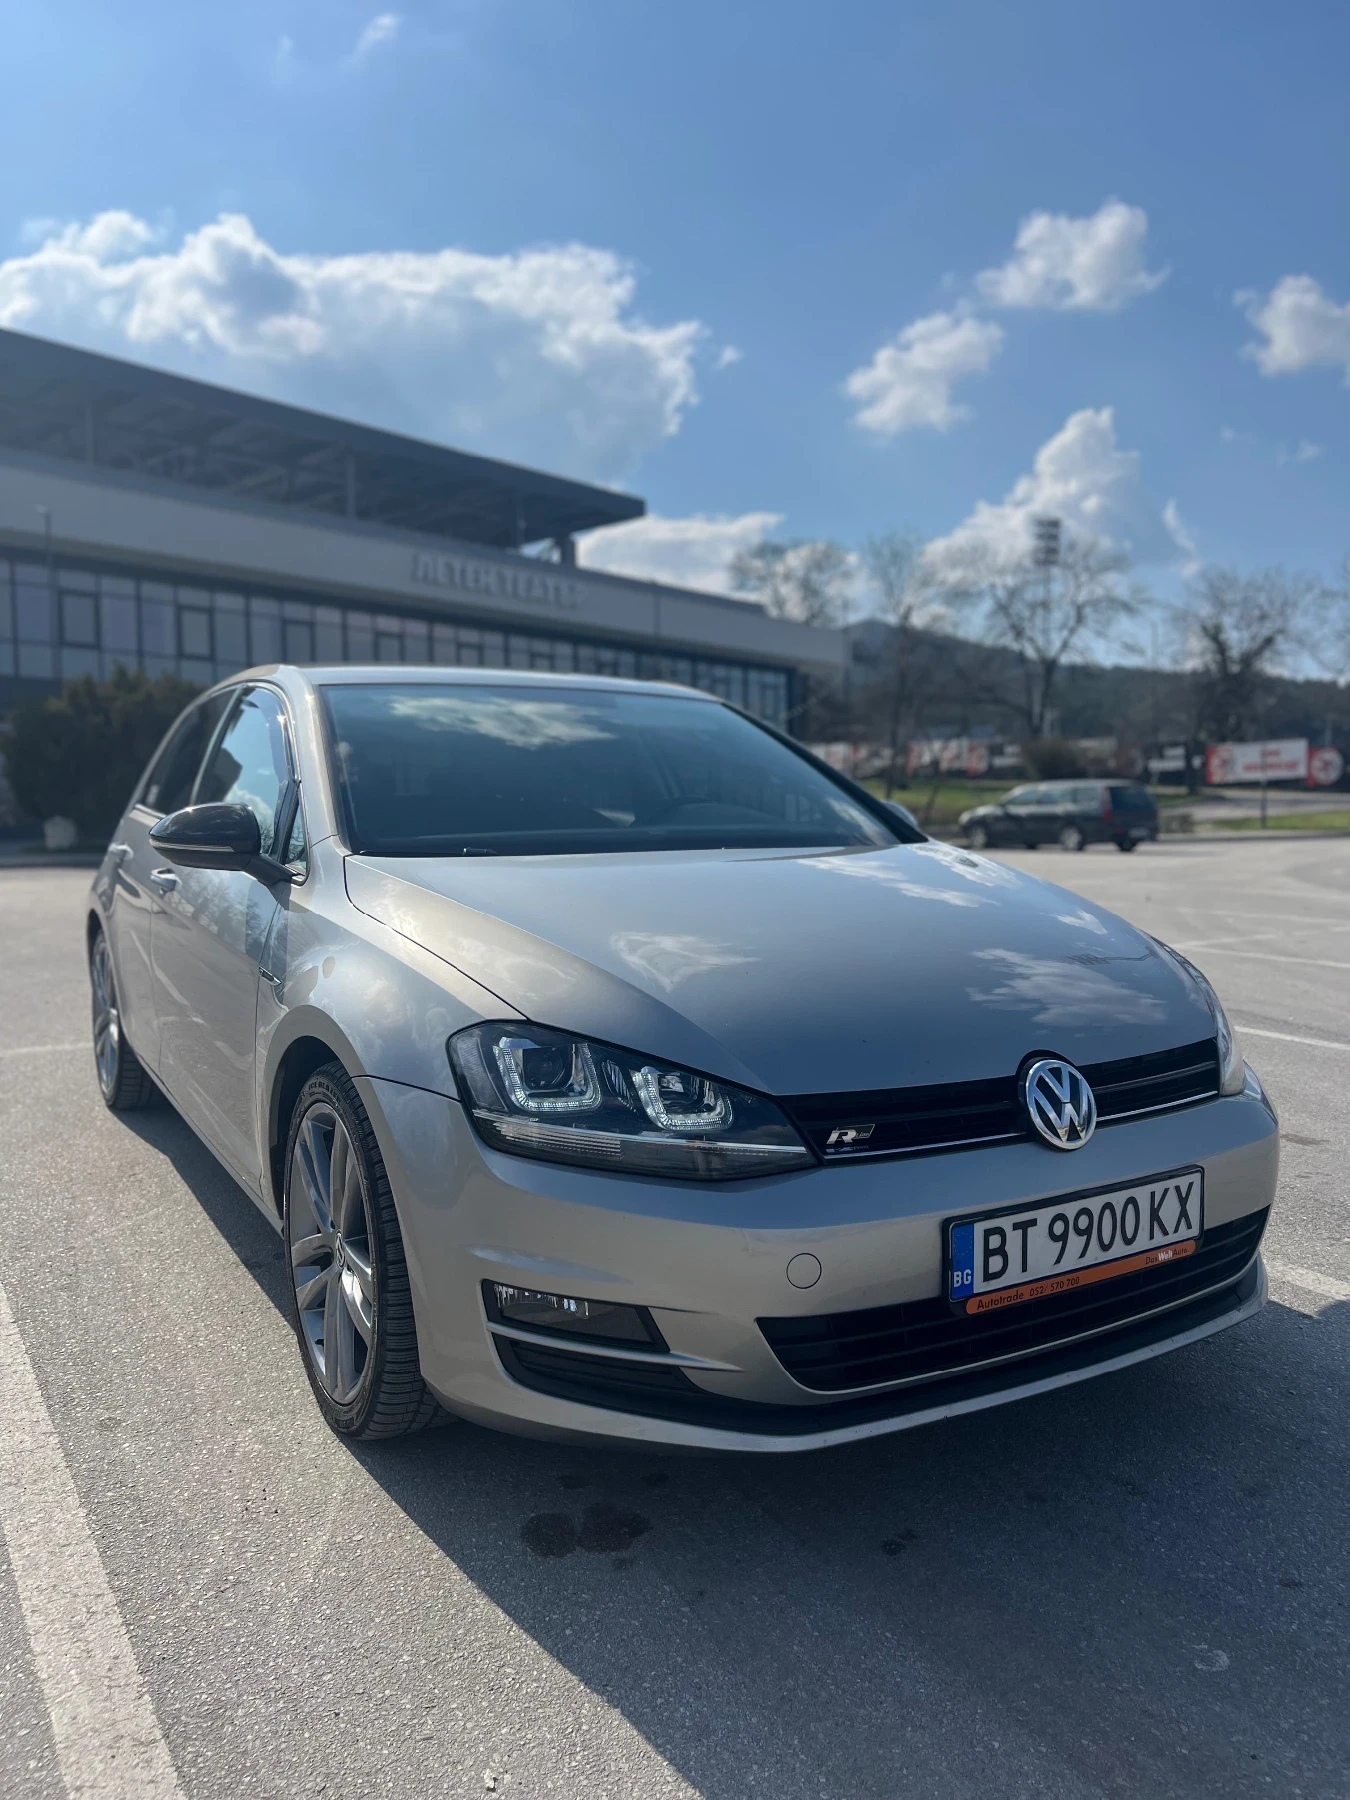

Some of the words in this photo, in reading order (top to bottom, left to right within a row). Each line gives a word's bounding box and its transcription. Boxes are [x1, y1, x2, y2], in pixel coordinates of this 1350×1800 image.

[826, 1129, 856, 1144] R
[982, 1217, 1038, 1283] BT
[1048, 1195, 1141, 1266] 9900
[1149, 1181, 1195, 1241] KX
[953, 1268, 972, 1288] BG
[976, 1290, 1024, 1311] Autotrade
[1050, 1280, 1065, 1292] 570
[1066, 1276, 1081, 1288] 700
